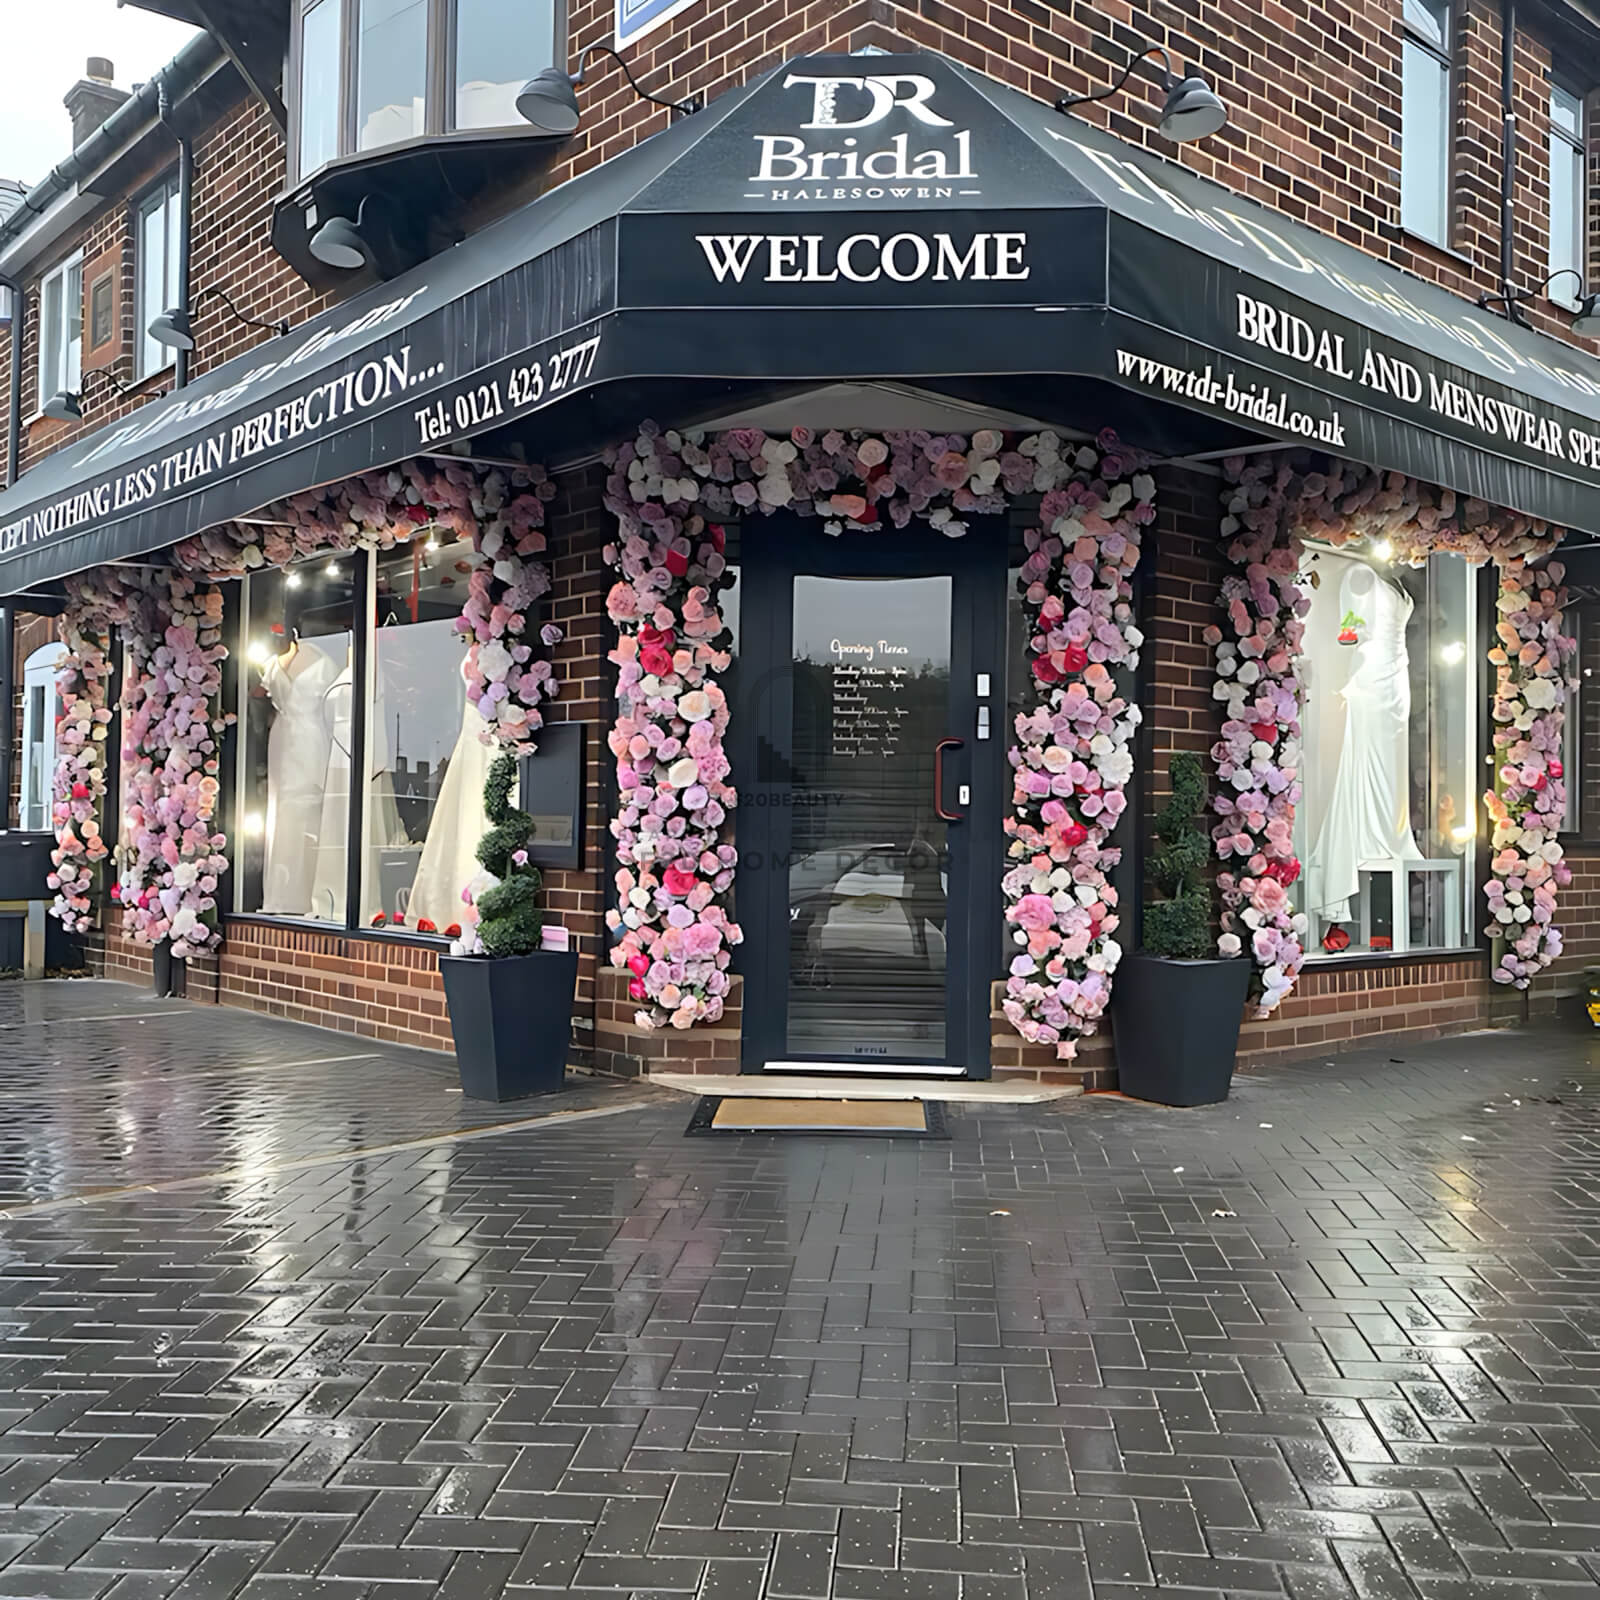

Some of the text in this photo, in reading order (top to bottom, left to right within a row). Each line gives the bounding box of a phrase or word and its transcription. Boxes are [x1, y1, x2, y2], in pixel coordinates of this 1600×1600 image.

[783, 74, 955, 129] TDR
[749, 129, 978, 181] Bridal
[772, 187, 953, 201] HALESOWEN
[695, 232, 1030, 284] WELCOME
[414, 335, 601, 444] Tel: 0121 423 2777
[1116, 349, 1346, 447] www.tdr-bridal.co.uk
[1236, 293, 1353, 380] BRIDAL
[1358, 348, 1422, 403] AND
[1427, 372, 1566, 459] MENSWEAR
[32, 482, 111, 542] NOTHING
[112, 464, 159, 511] LESS
[160, 431, 227, 491] THAN
[830, 638, 874, 661] Opening
